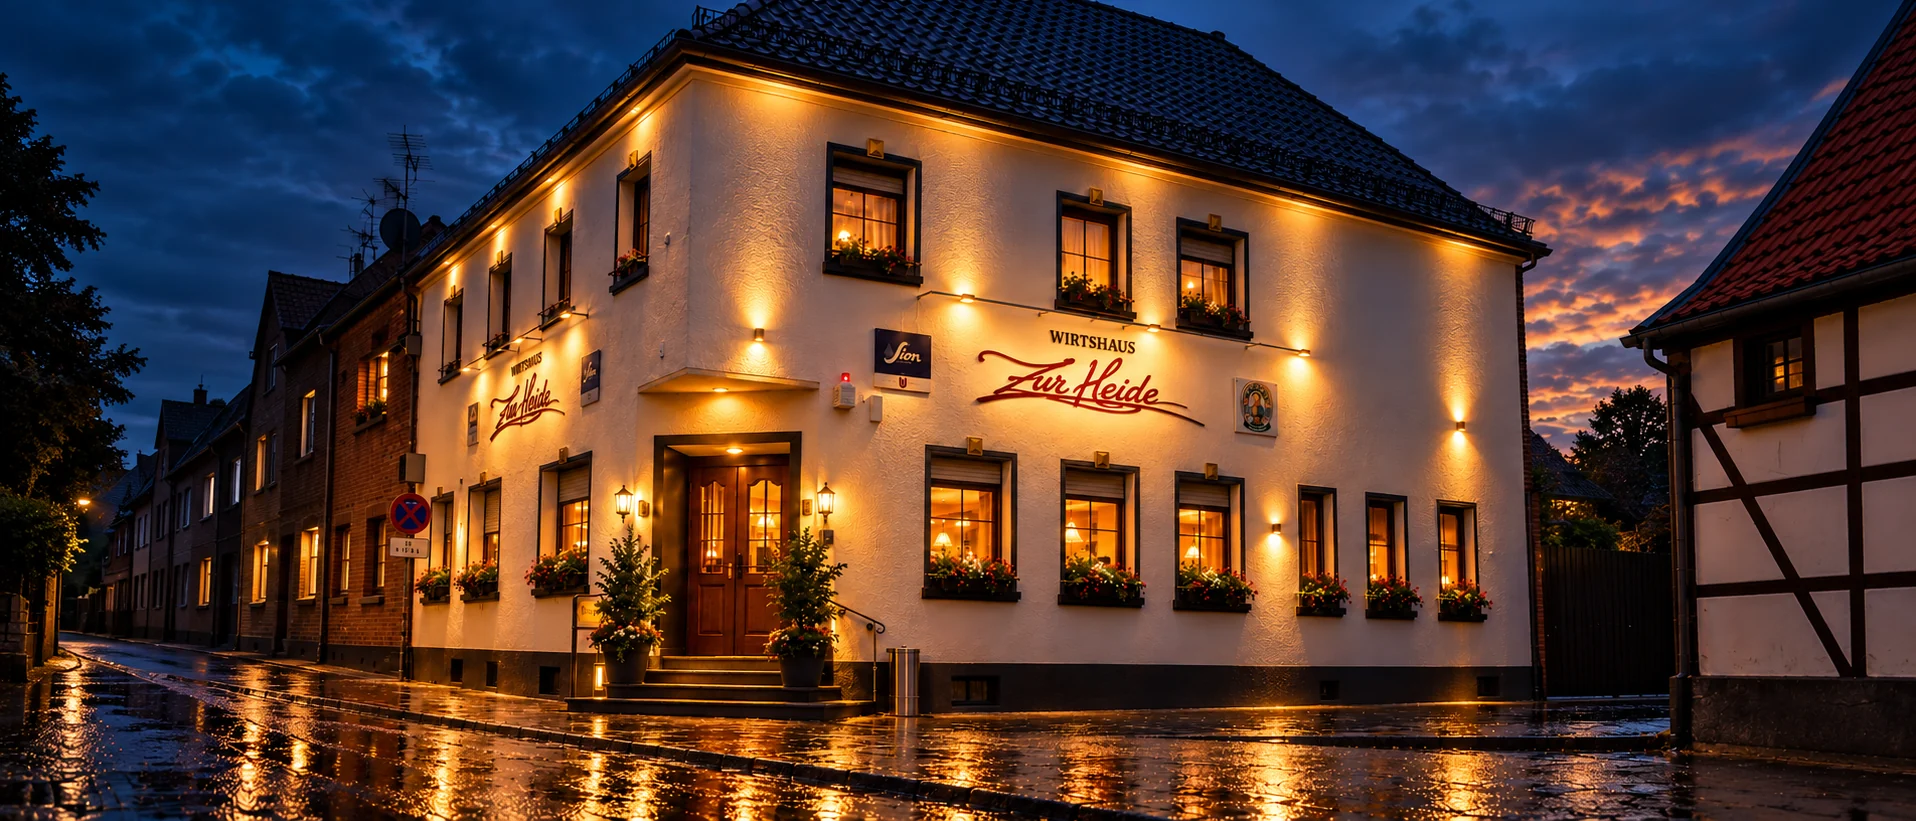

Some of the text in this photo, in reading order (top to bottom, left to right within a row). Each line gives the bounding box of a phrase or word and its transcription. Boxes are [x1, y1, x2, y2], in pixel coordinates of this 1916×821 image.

[883, 341, 922, 364] Sion
[1050, 329, 1136, 354] WIRTSHAUS
[516, 372, 560, 421] Heide
[976, 350, 1076, 403] Zur
[1072, 357, 1187, 414] Heide
